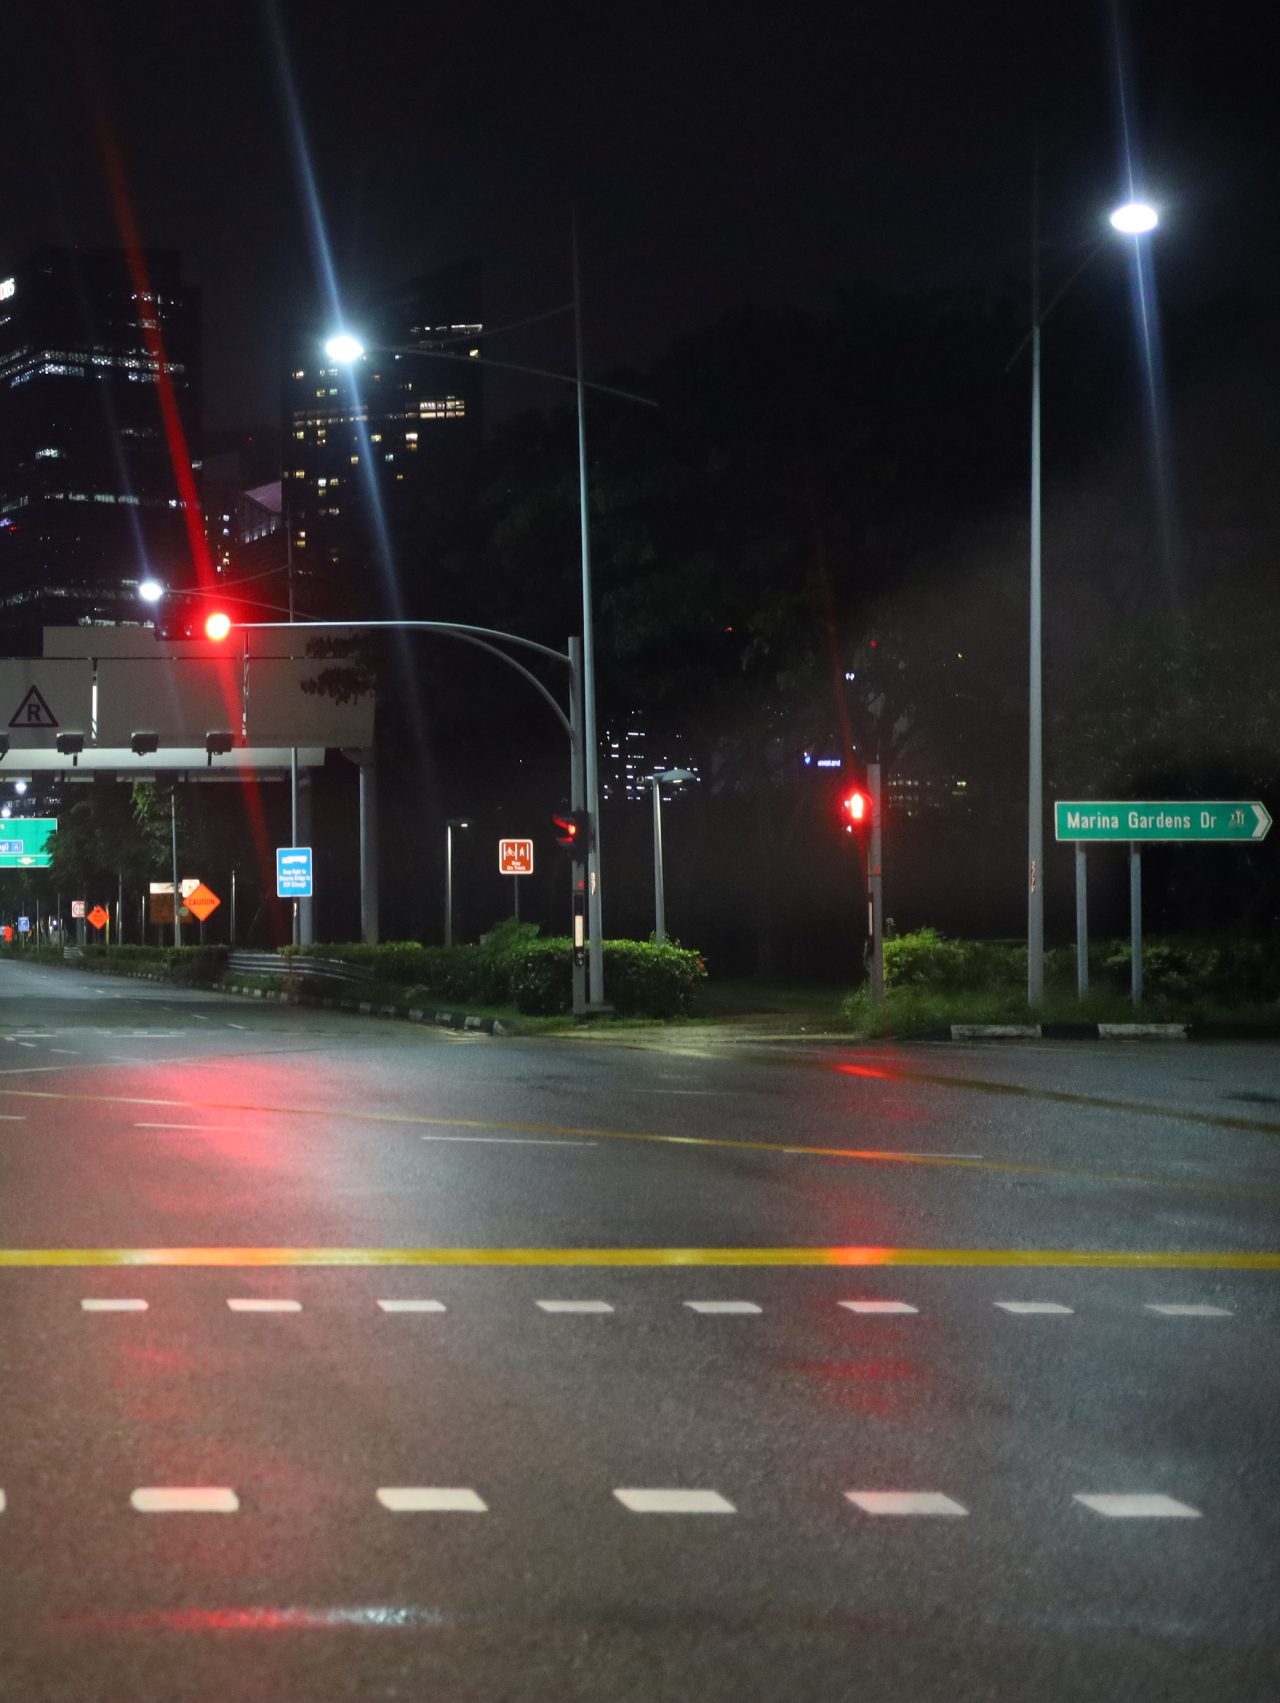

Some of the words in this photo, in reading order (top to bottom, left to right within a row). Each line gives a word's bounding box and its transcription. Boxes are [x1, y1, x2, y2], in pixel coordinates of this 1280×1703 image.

[27, 703, 41, 722] R
[1067, 811, 1119, 829] Marina
[1128, 811, 1191, 829] Gardens
[1200, 811, 1217, 829] Dr
